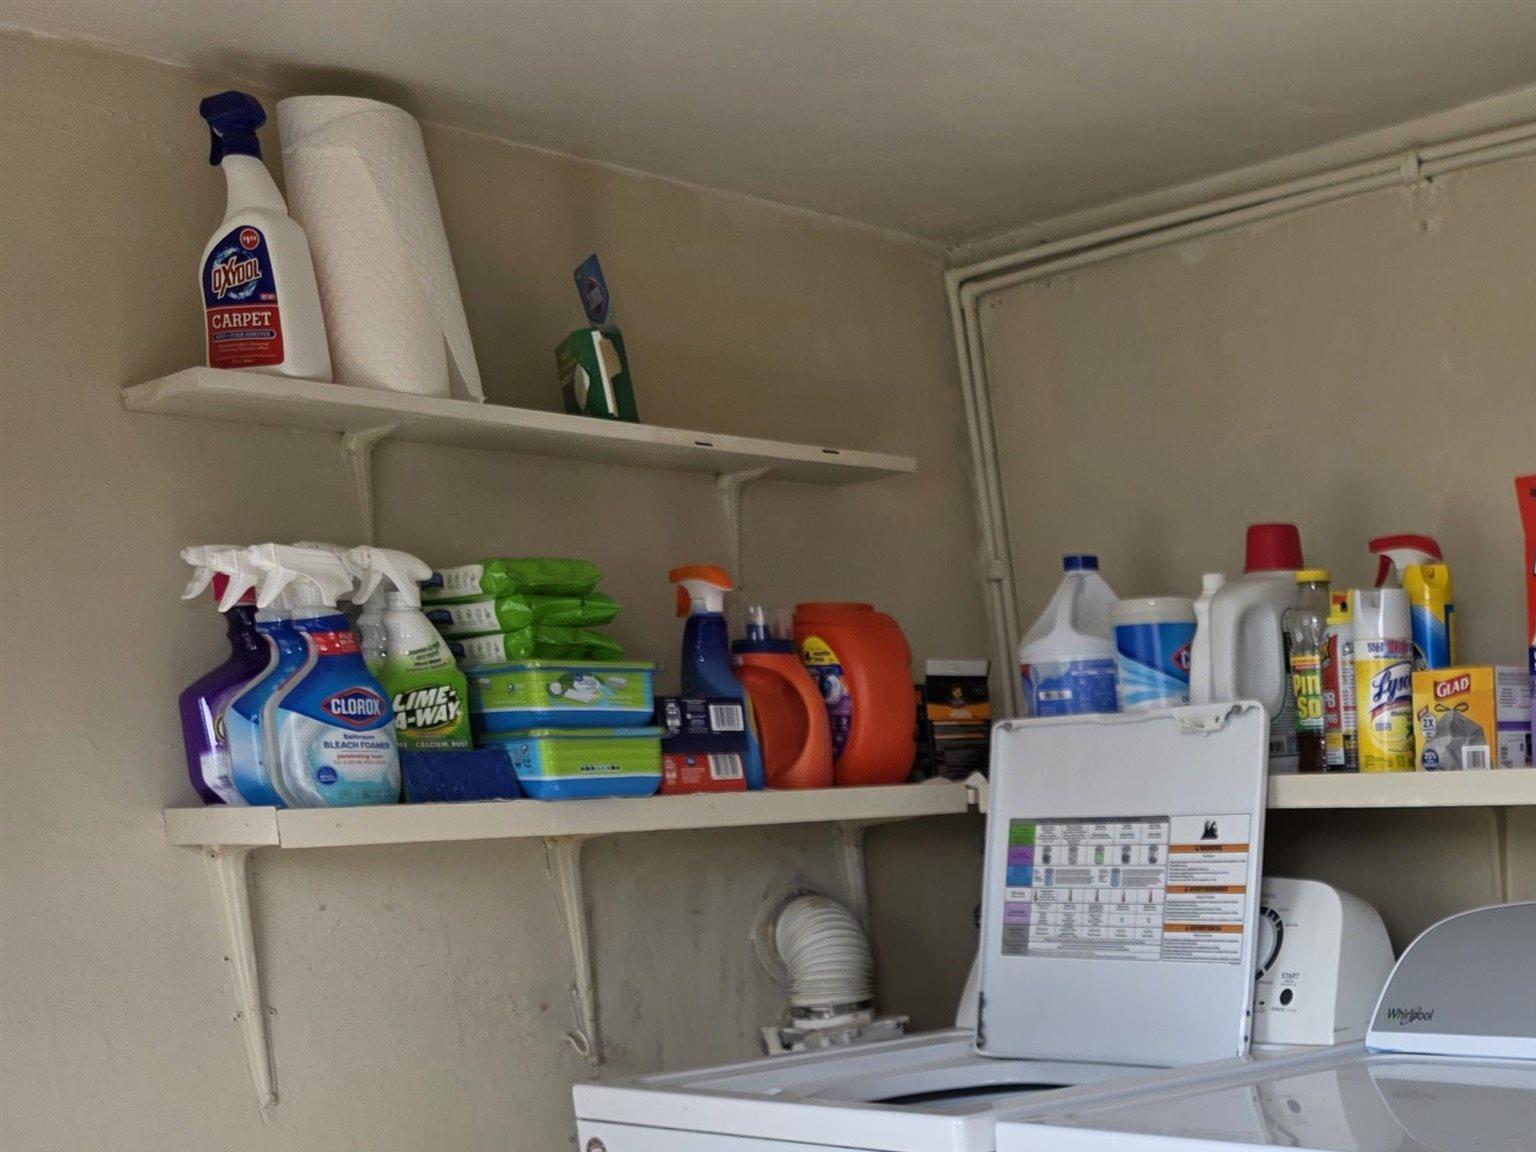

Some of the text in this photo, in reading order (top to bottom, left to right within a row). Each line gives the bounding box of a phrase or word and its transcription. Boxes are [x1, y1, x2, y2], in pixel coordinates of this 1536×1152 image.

[211, 256, 262, 299] OXYDOL
[212, 312, 272, 329] CARPET
[1292, 674, 1321, 697] Pin
[1436, 677, 1469, 698] GLAD
[330, 698, 381, 716] CLOROX
[1297, 696, 1321, 720] So
[323, 741, 359, 749] BLEACH
[1387, 1006, 1435, 1025] Whirlpool
